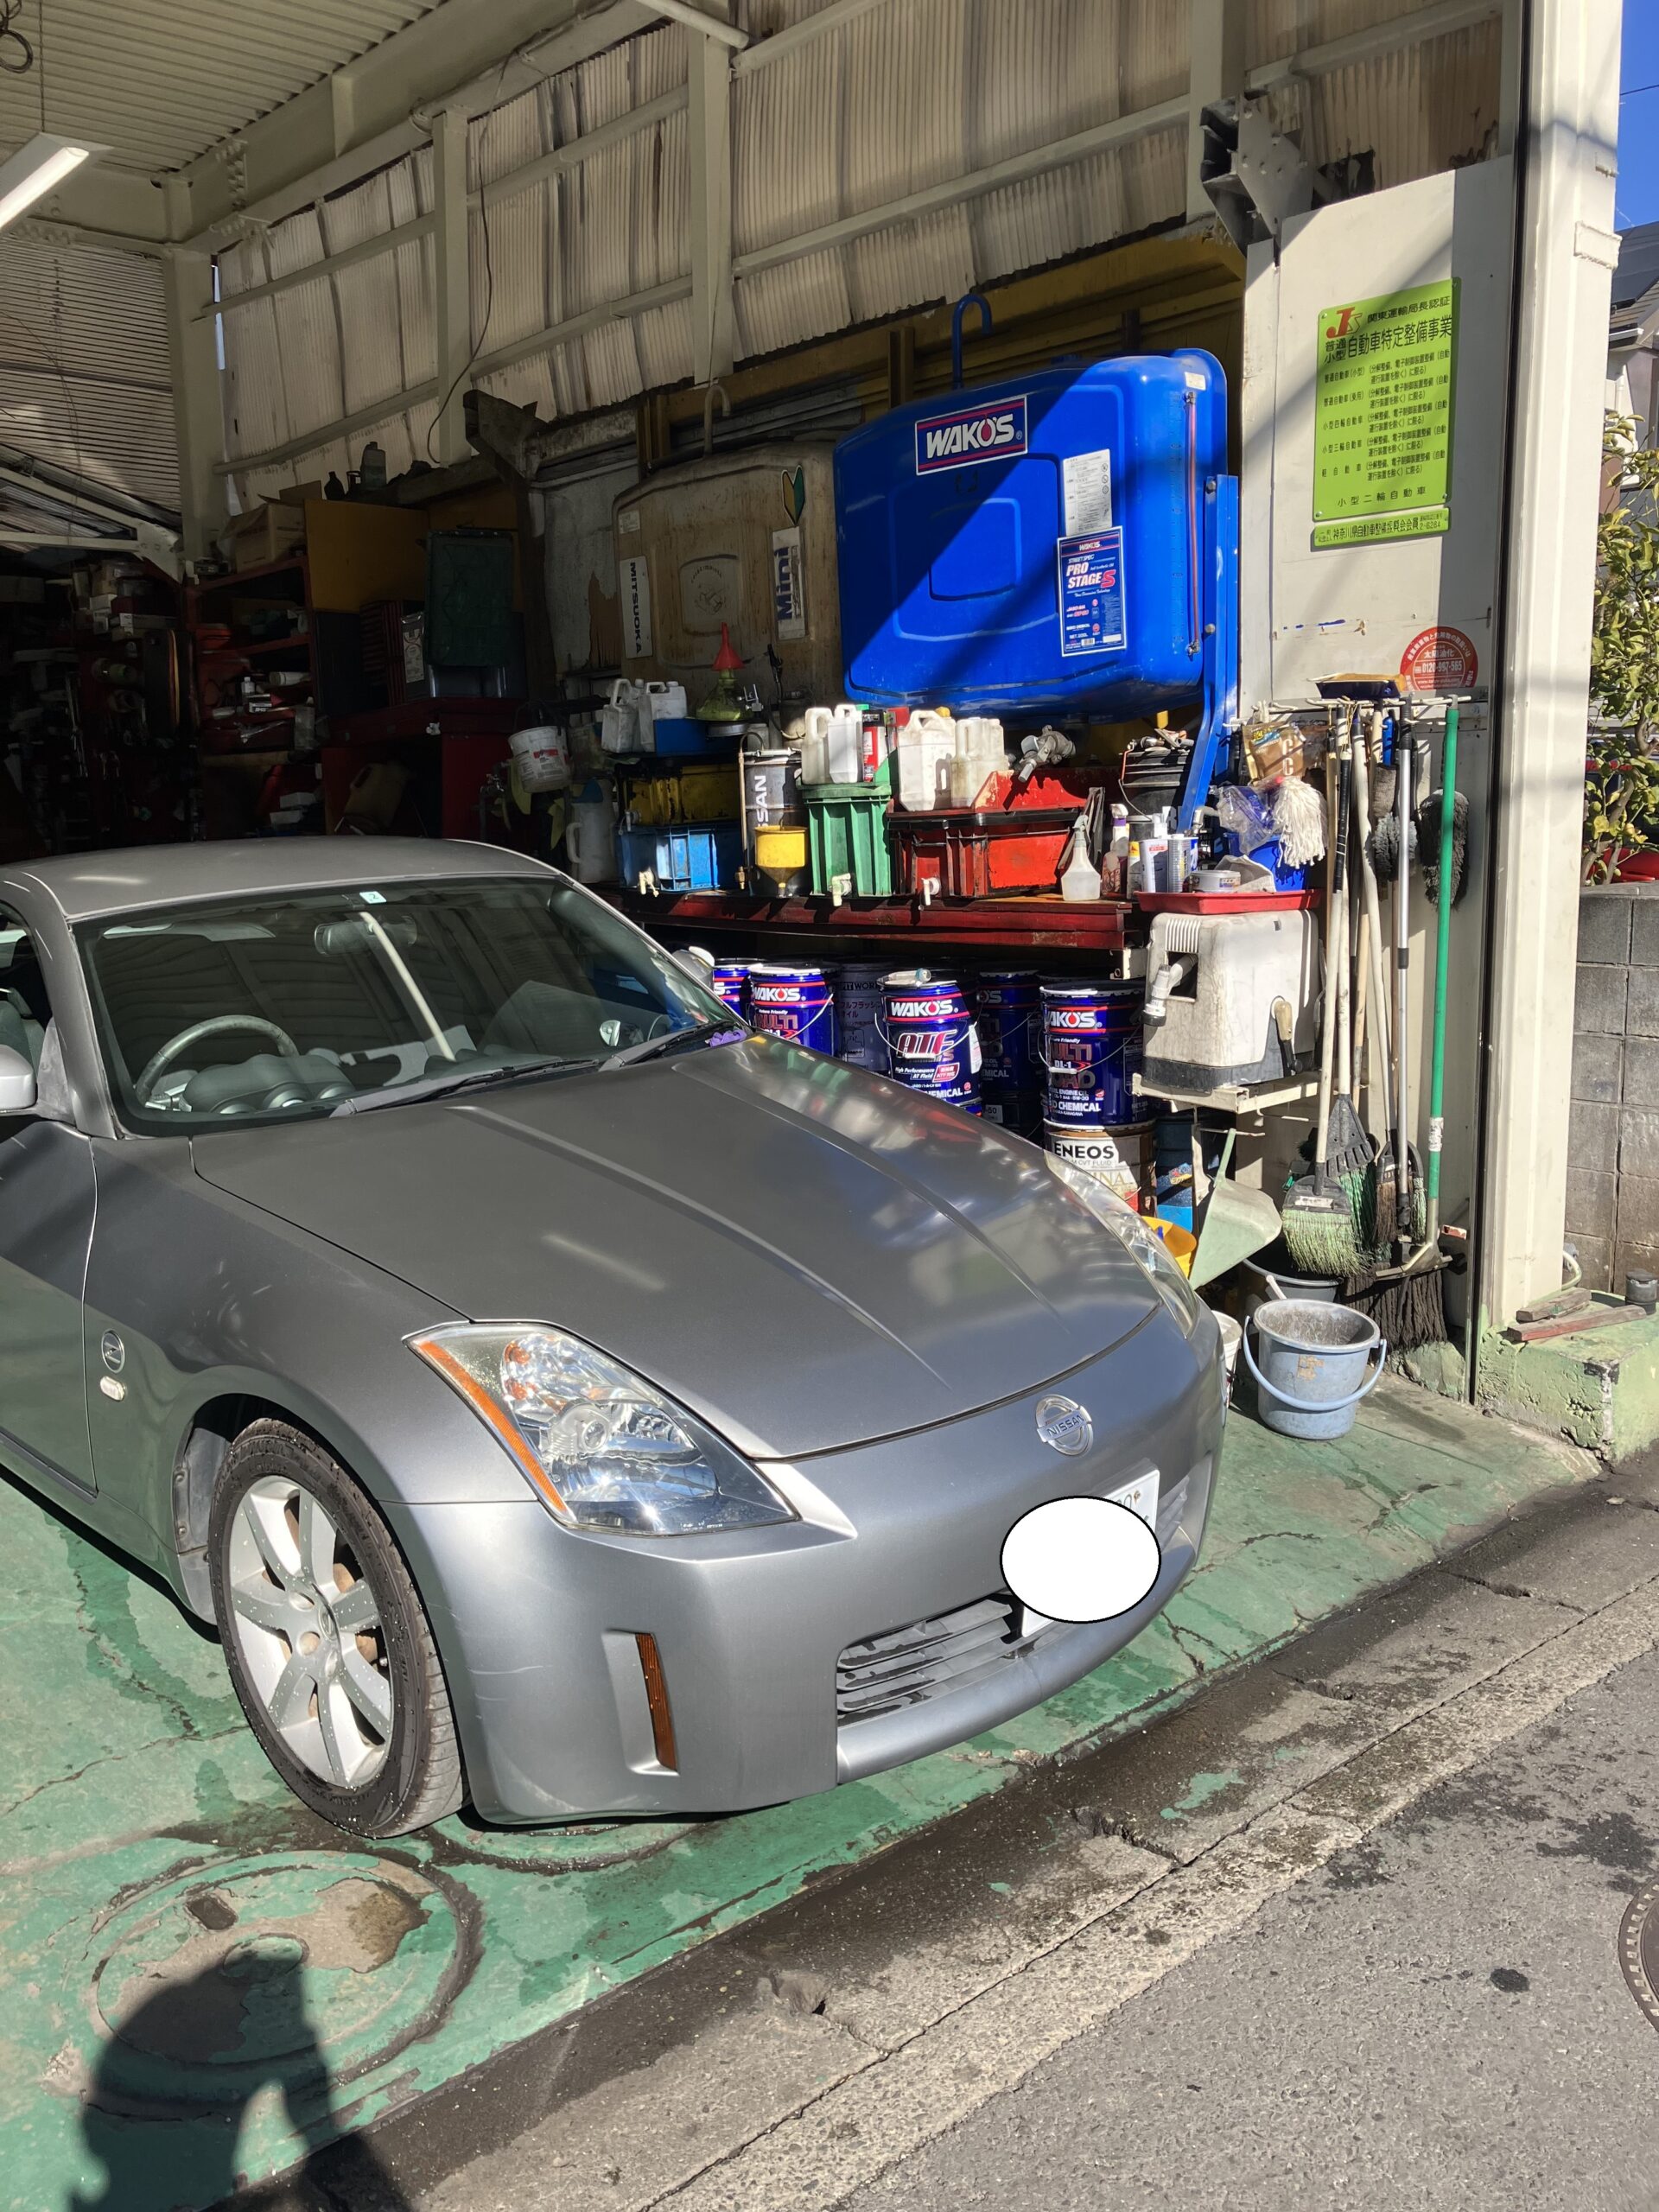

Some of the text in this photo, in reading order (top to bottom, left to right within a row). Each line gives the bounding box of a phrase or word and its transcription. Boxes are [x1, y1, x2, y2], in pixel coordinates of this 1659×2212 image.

[1066, 562, 1089, 577] PRO
[1068, 572, 1103, 588] STAGE
[630, 562, 642, 654] MITSUOKA
[754, 775, 768, 828] SAN
[1052, 1043, 1092, 1061] ULTI
[1054, 1142, 1114, 1160] ENEOS
[1046, 1414, 1084, 1437] NISSAN
